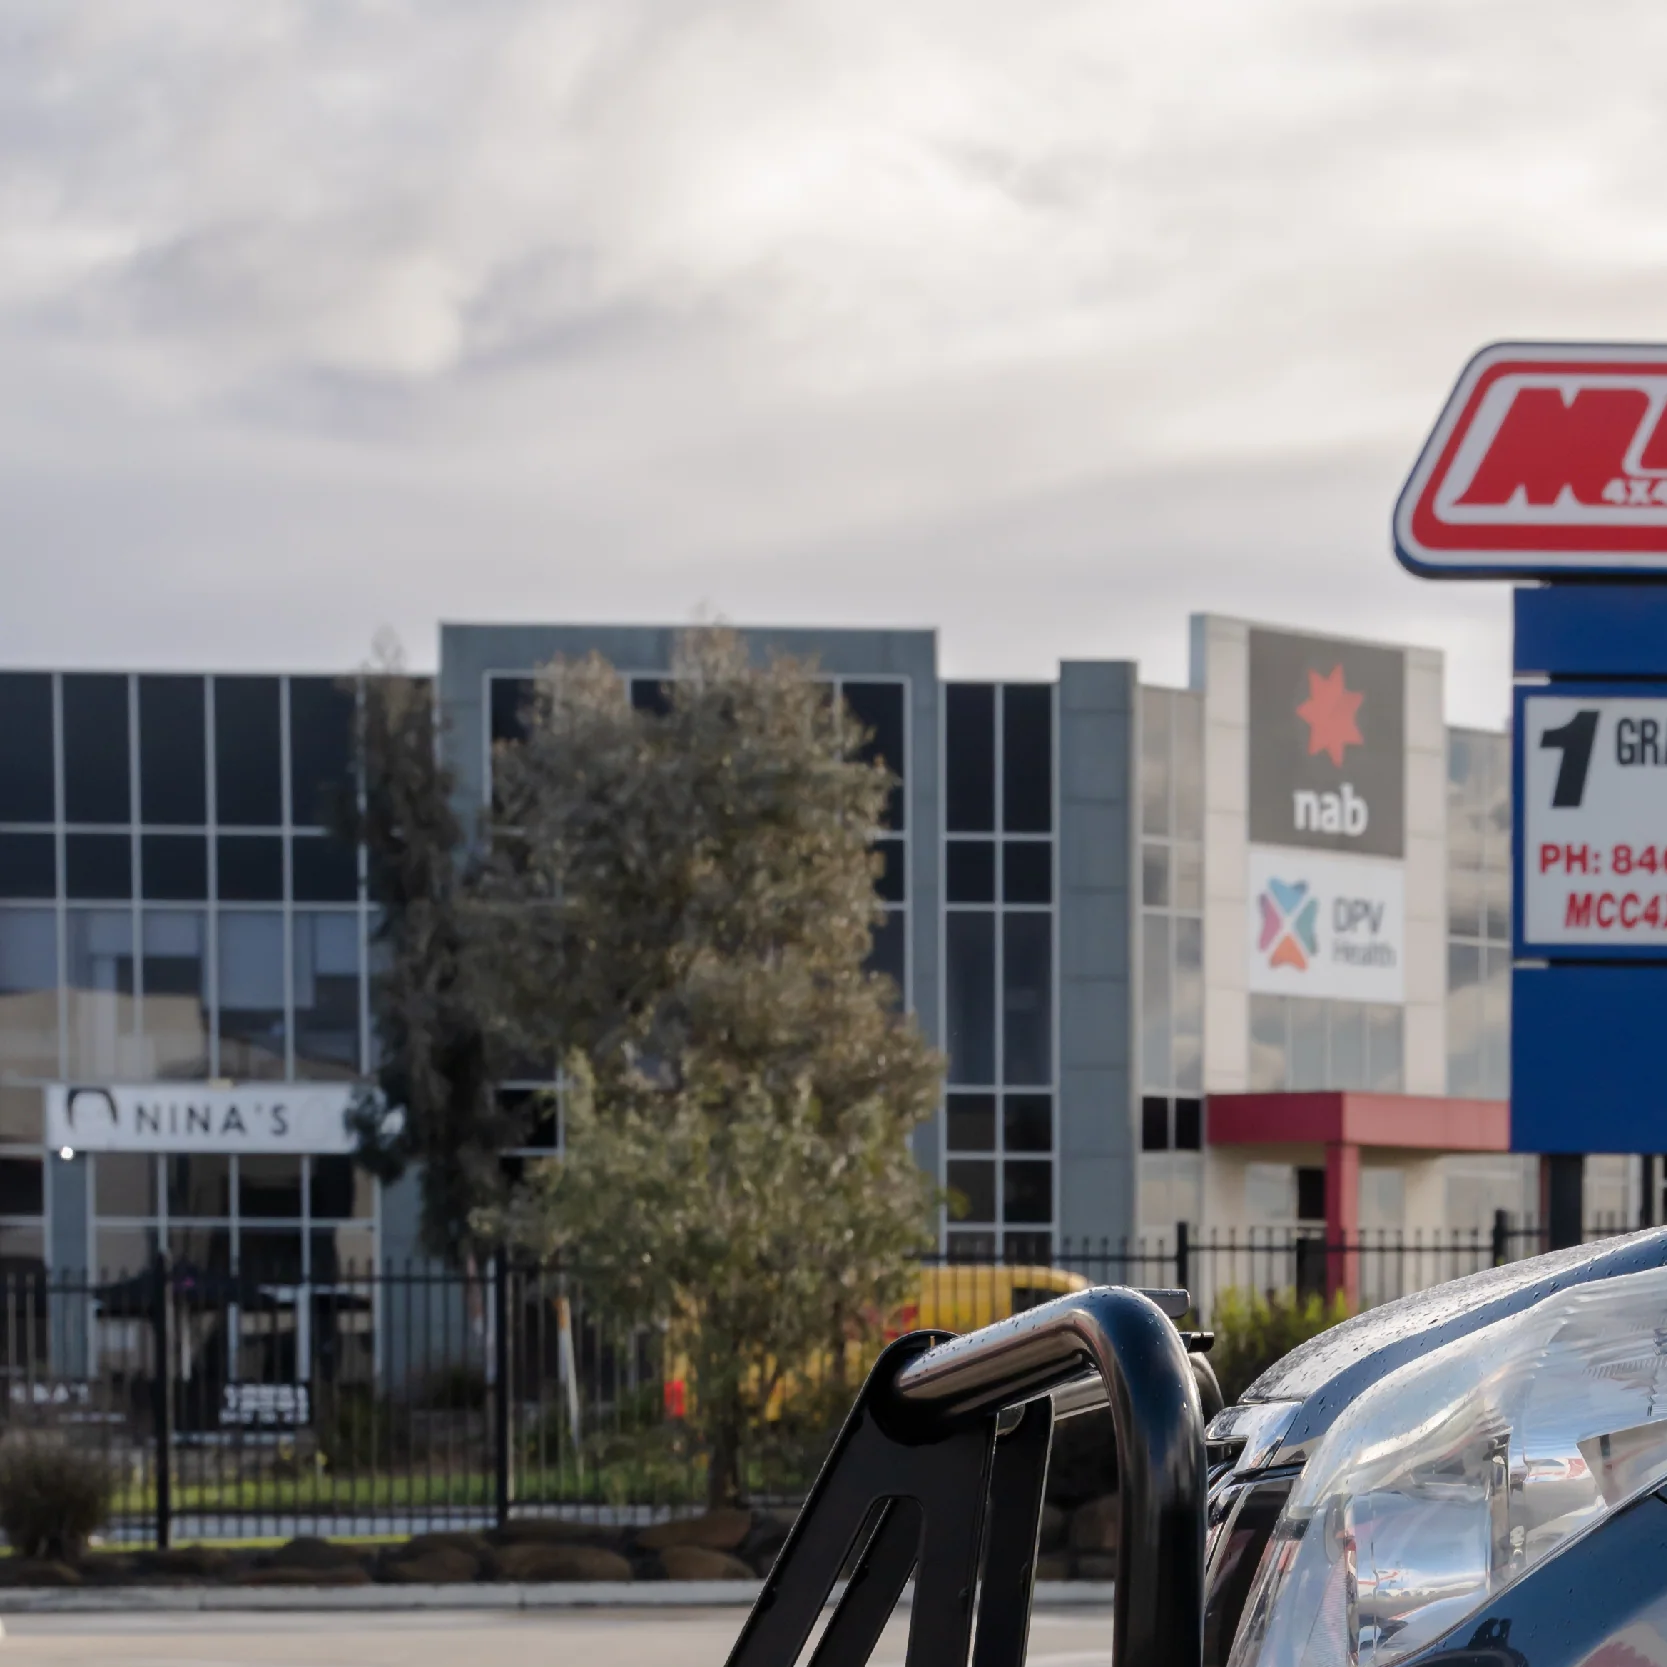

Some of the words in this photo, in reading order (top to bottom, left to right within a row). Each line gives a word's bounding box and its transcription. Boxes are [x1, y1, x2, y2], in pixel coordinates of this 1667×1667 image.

[1539, 709, 1602, 808] 1
[1294, 783, 1369, 837] nab
[135, 1103, 290, 1137] NINA'S
